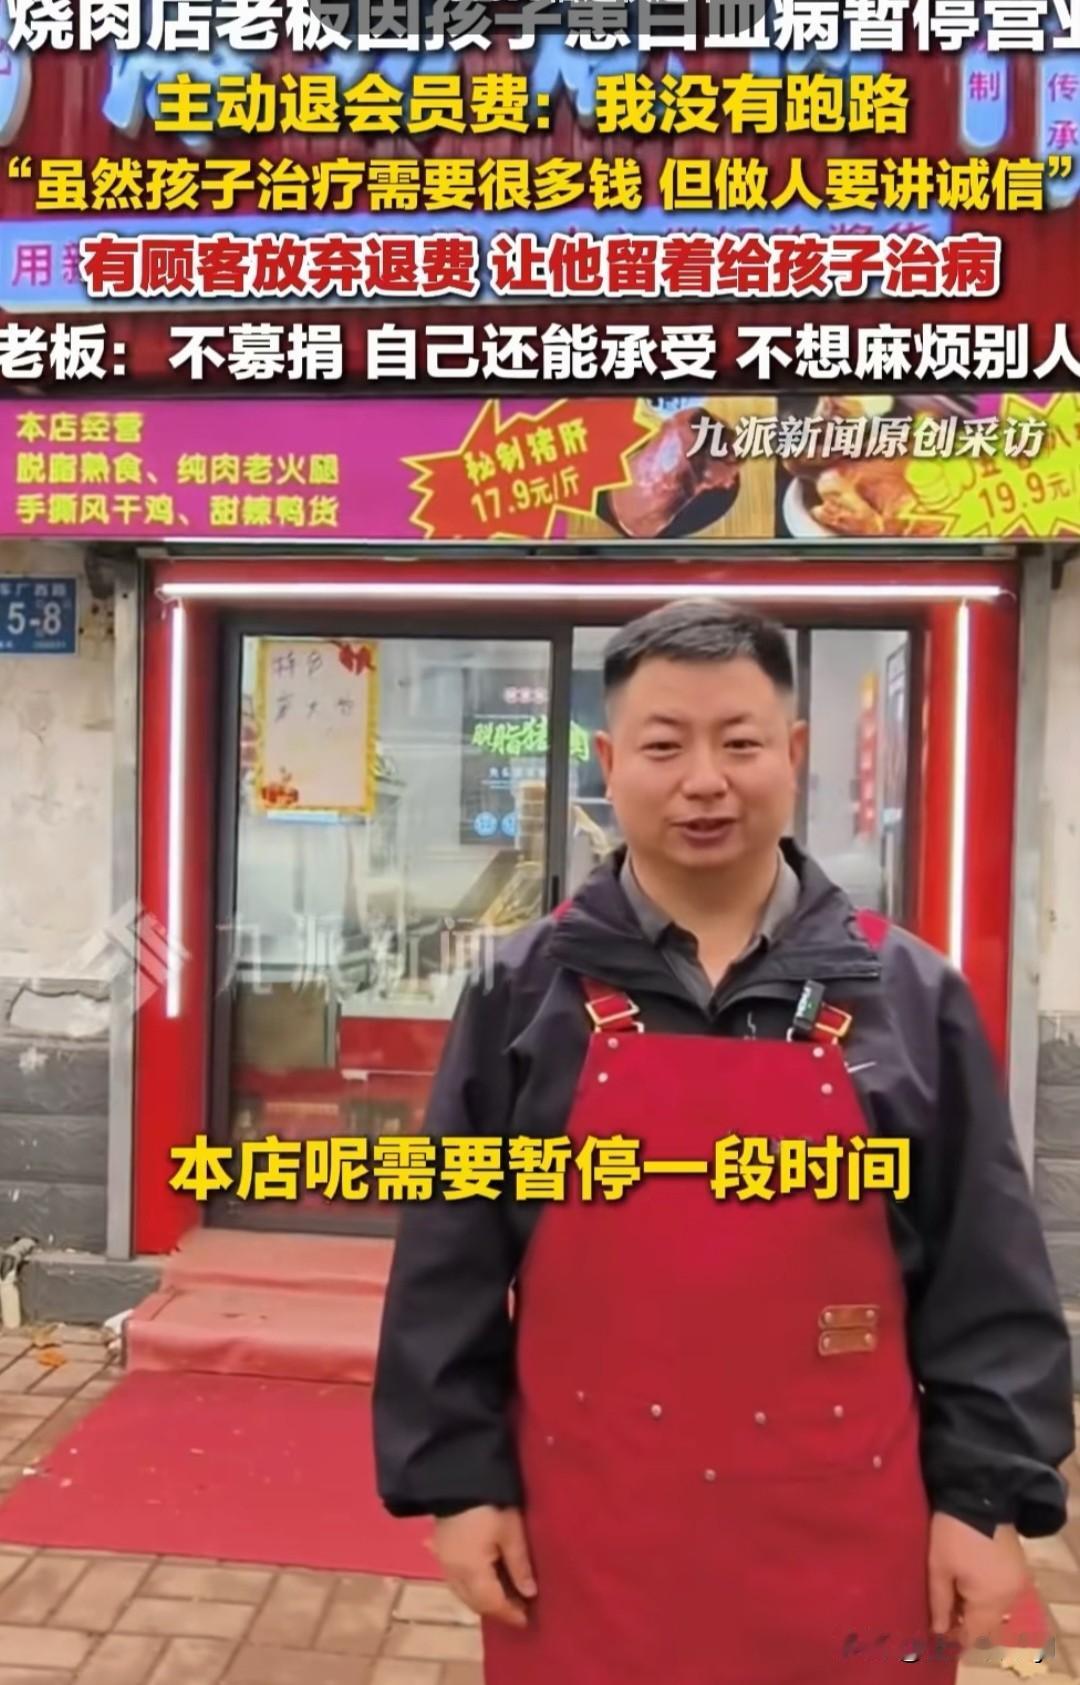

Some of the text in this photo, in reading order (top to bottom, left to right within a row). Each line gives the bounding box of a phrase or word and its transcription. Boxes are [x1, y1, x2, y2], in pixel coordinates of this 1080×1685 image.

[16, 411, 143, 443] 本店经营
[470, 465, 580, 522] 17.9元/斤
